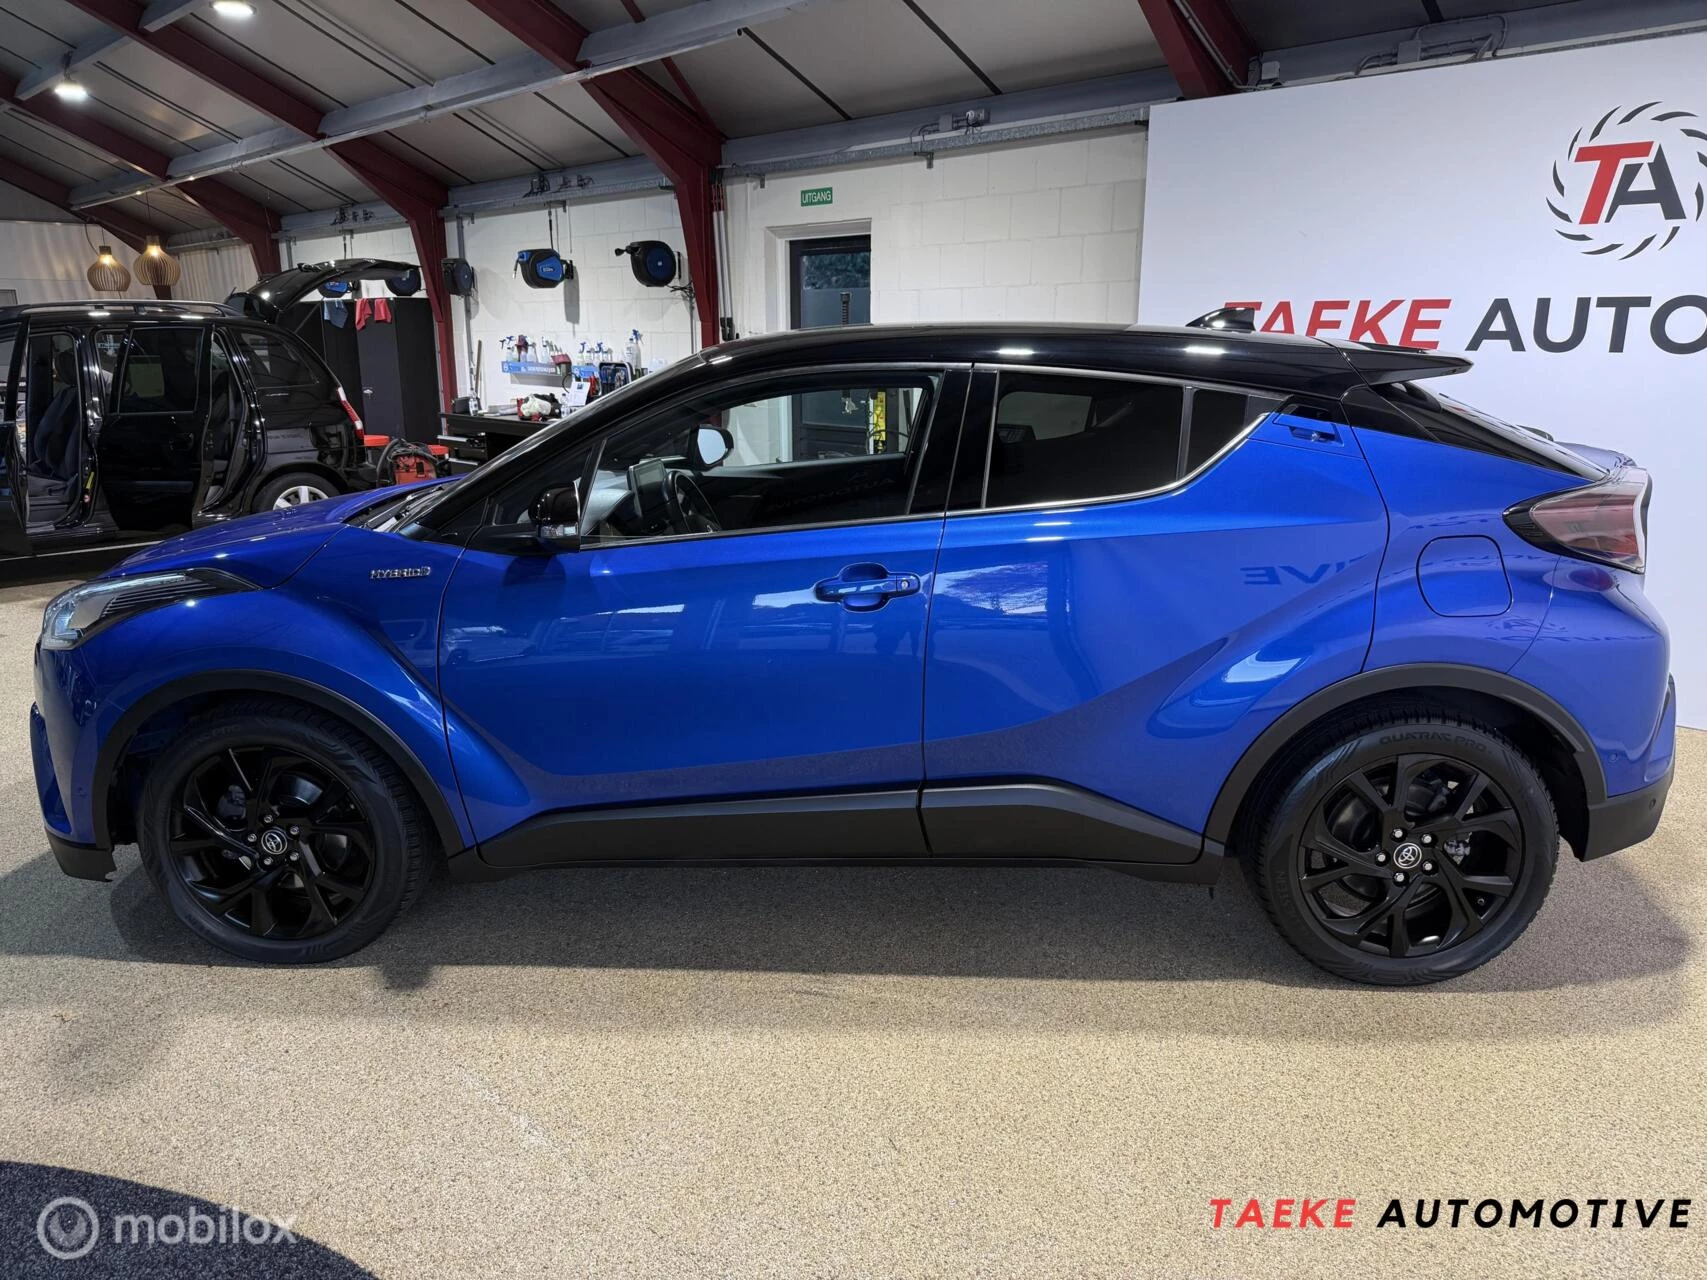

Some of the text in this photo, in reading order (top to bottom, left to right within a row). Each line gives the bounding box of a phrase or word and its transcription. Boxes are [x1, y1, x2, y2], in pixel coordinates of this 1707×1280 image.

[1575, 141, 1687, 225] TA
[802, 190, 832, 204] UITGANG
[369, 566, 432, 579] HYBRID
[1455, 735, 1487, 752] PRO
